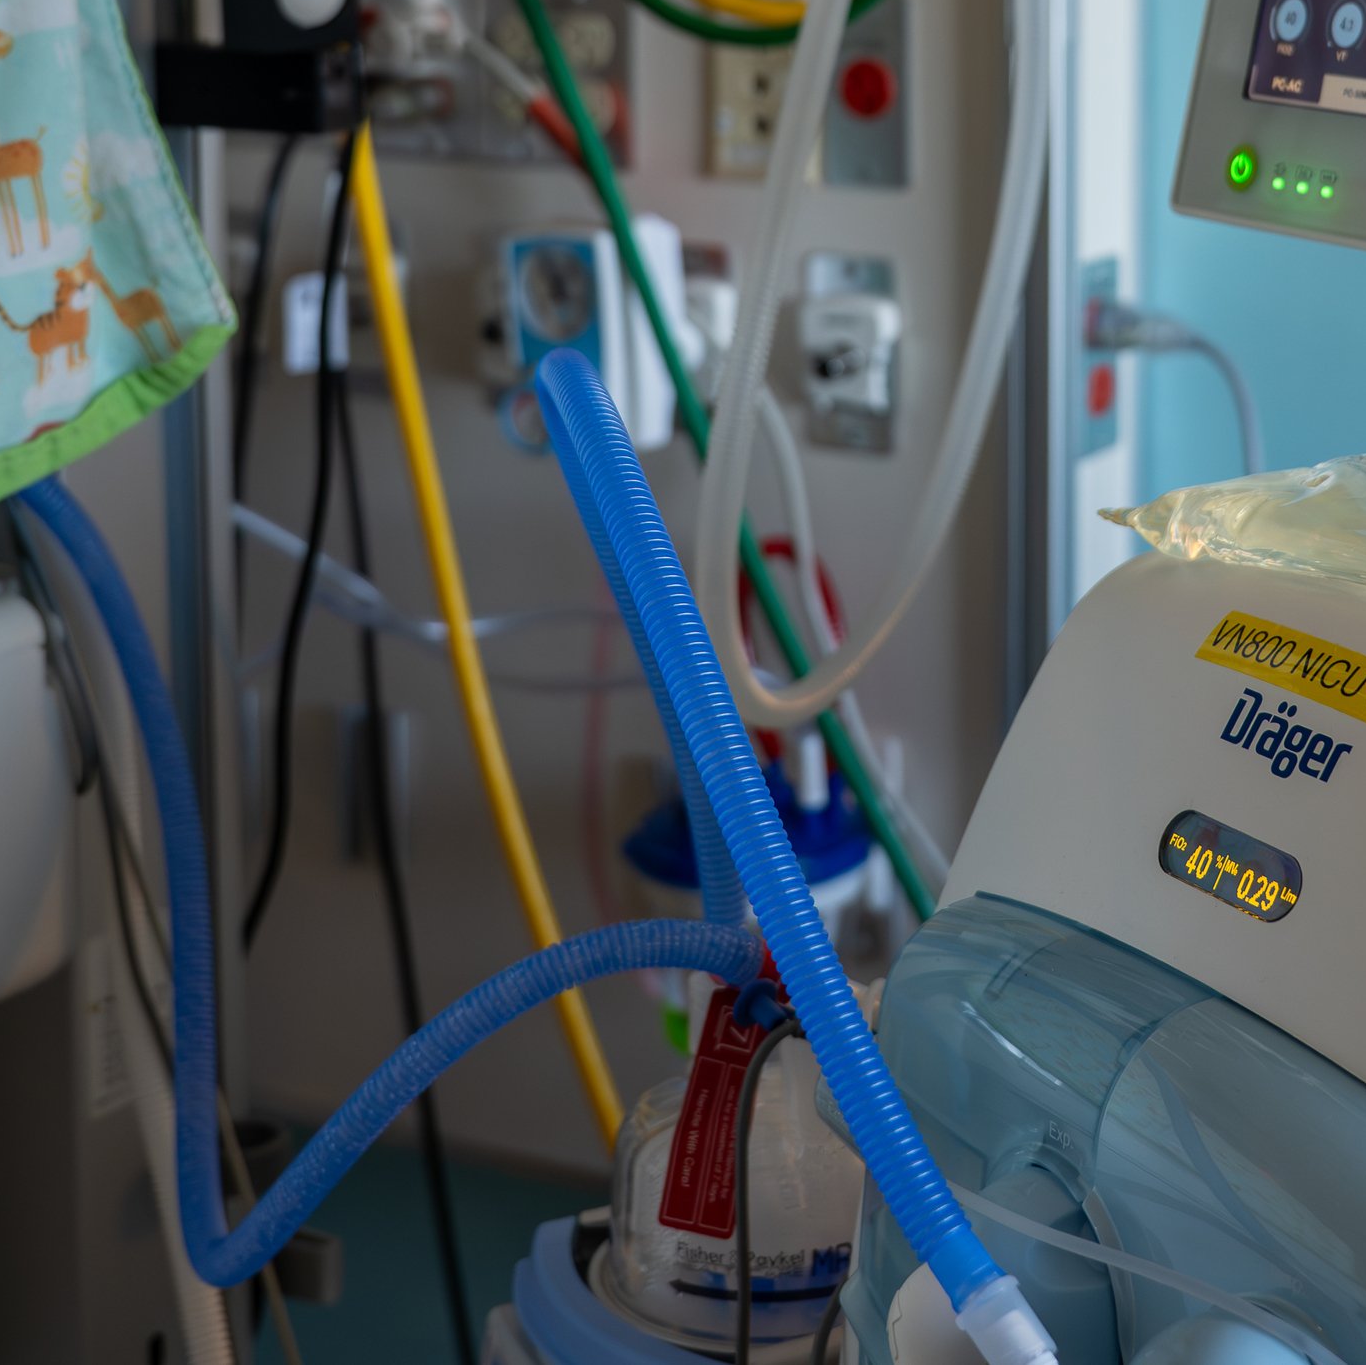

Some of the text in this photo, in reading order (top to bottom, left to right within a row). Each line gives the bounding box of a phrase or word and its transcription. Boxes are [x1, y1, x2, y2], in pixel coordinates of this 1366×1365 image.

[1213, 619, 1297, 668] VN800
[1220, 687, 1353, 783] Dräger
[1185, 845, 1213, 879] 40
[1237, 869, 1280, 911] 0.29
[685, 1130, 699, 1154] With
[1049, 1120, 1074, 1149] Exp.
[677, 1241, 725, 1264] Fisher
